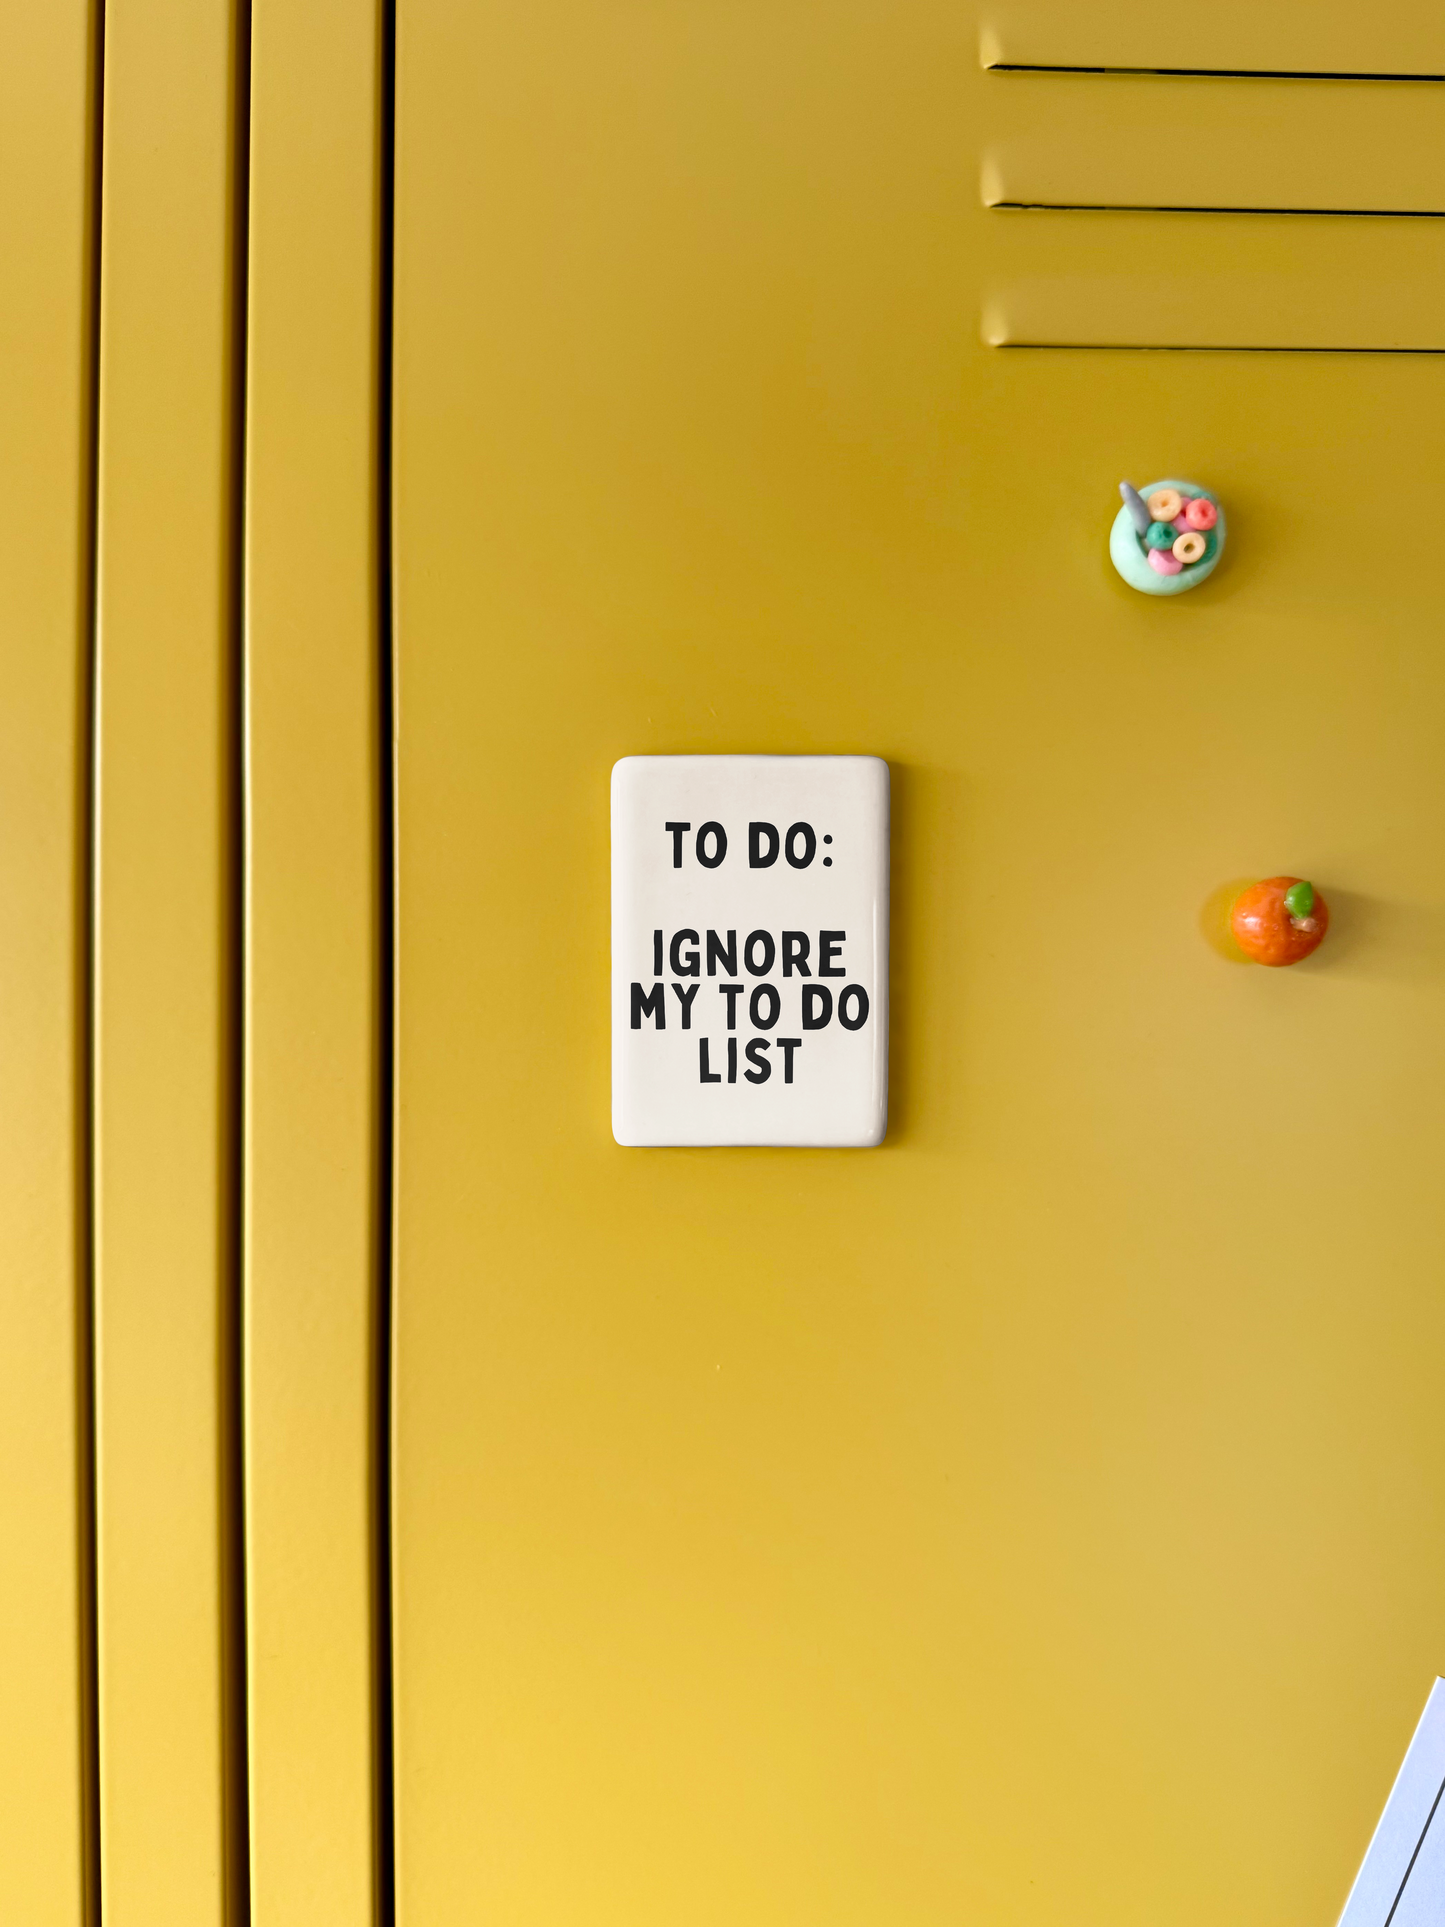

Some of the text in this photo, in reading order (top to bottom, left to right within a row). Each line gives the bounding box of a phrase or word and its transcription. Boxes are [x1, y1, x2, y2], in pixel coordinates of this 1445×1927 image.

[665, 821, 833, 870] TO DO:
[653, 929, 847, 978] IGNORE
[630, 982, 870, 1032] MY TO DO
[699, 1037, 802, 1085] LIST
